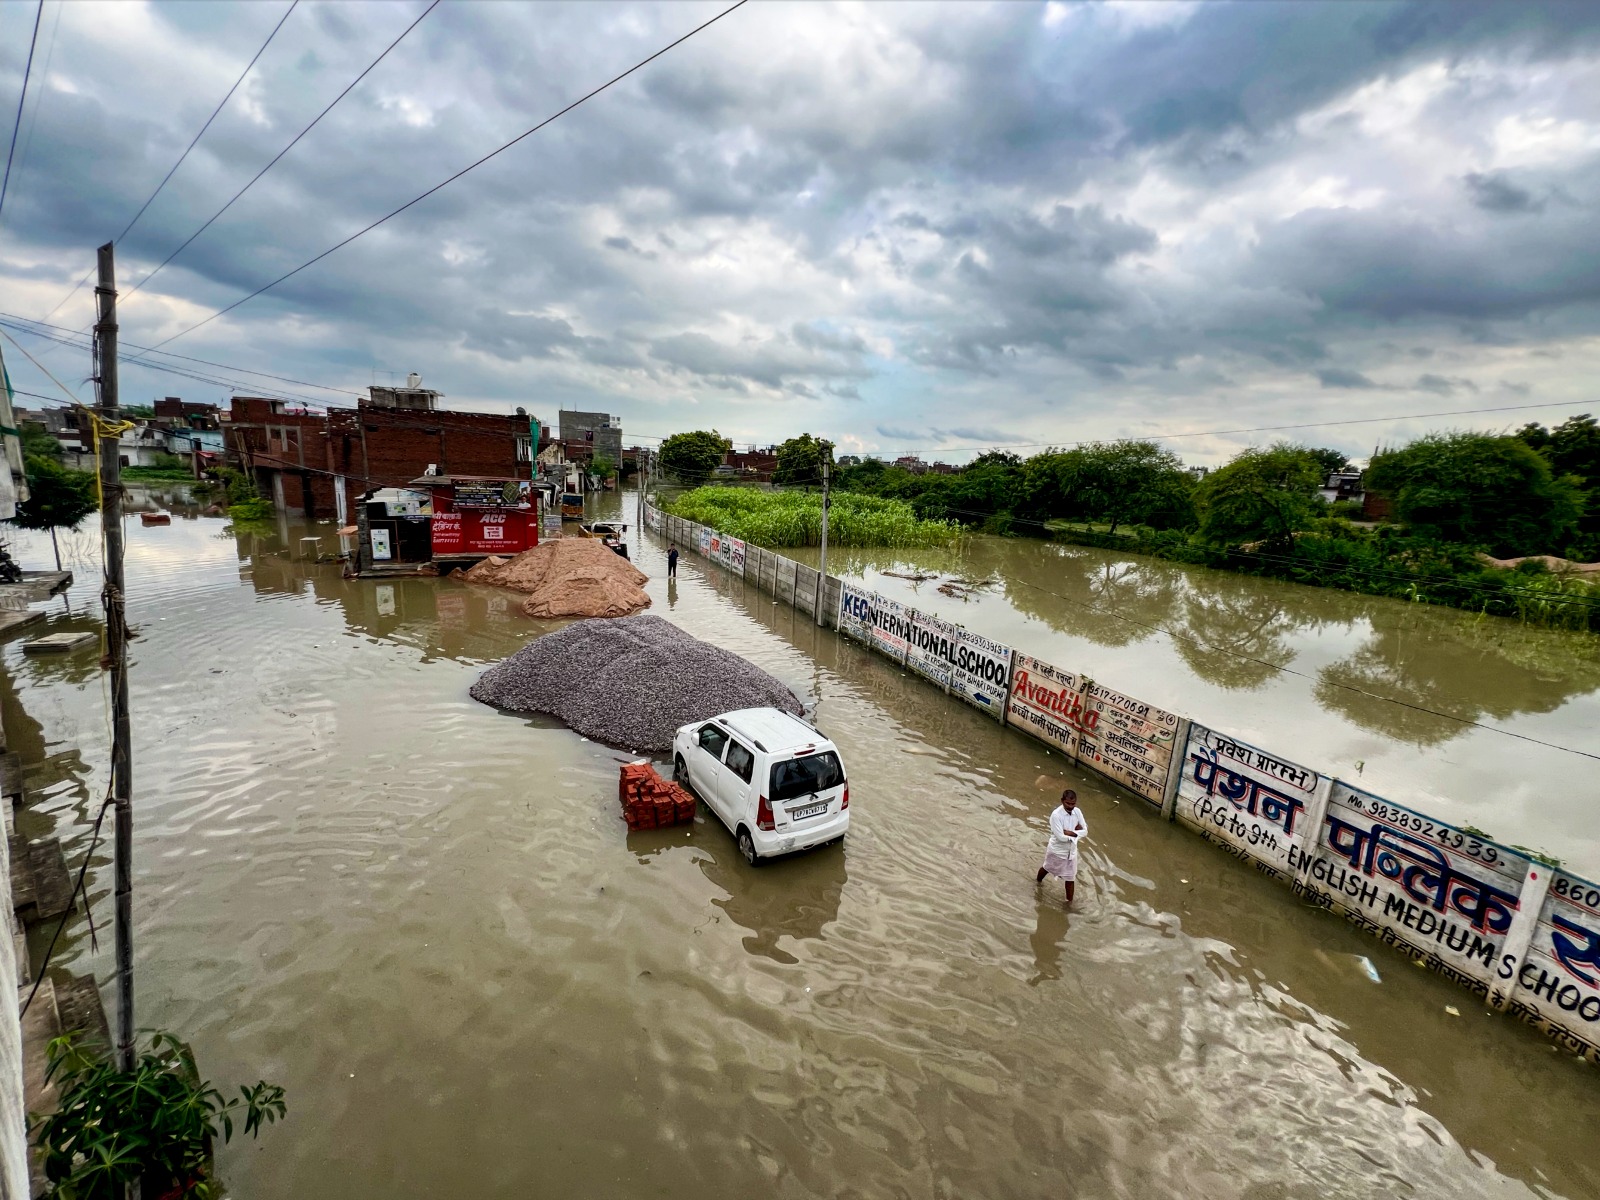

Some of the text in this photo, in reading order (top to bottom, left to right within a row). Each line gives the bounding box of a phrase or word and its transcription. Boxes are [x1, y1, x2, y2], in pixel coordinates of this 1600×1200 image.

[480, 514, 507, 523] ACC
[844, 593, 868, 621] KEC
[868, 606, 957, 666] INTERNATIONAL
[958, 646, 1008, 689] SCHOOL
[1012, 670, 1100, 730] Avantika
[1089, 685, 1150, 717] 9517470691
[1012, 703, 1028, 720] कच्ची
[1079, 736, 1097, 759] तेल
[1287, 843, 1378, 909] ENGLISH
[1384, 892, 1496, 968] MEDIUM
[1326, 823, 1520, 935] पब्लिक
[1491, 988, 1503, 1009] के
